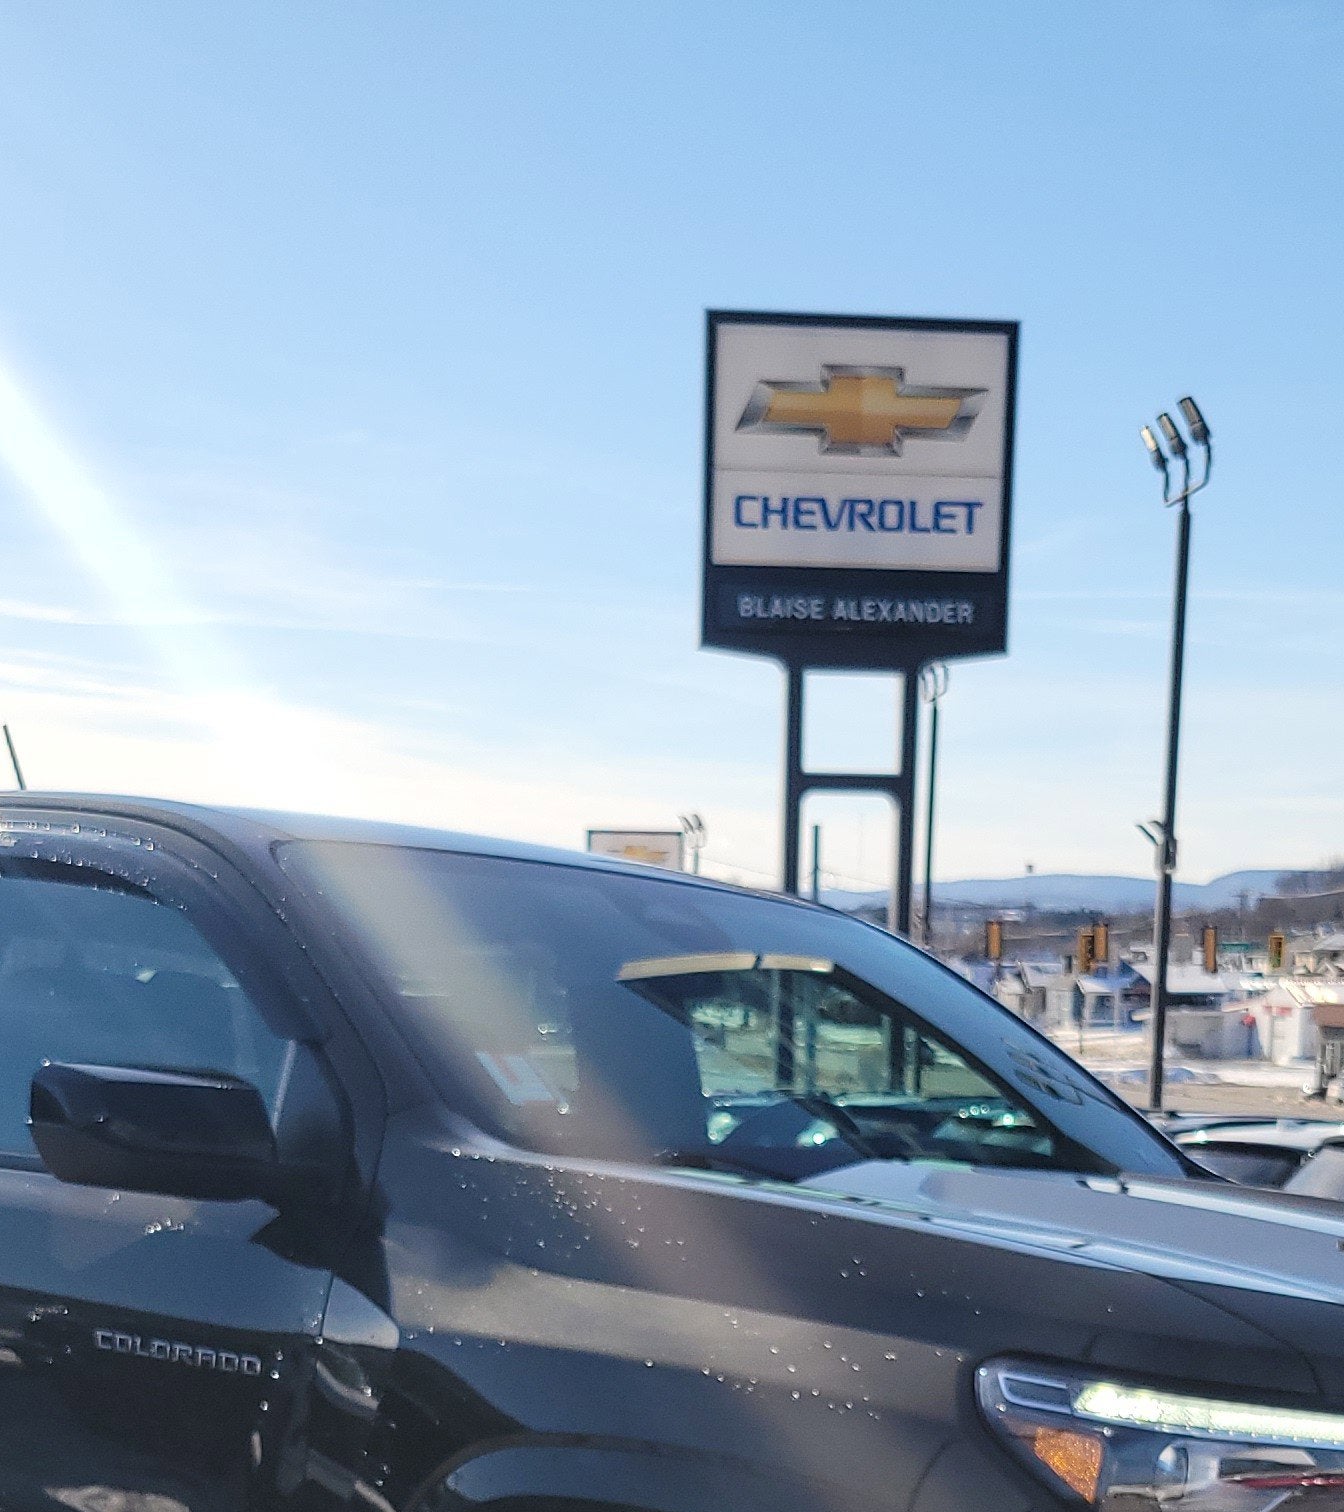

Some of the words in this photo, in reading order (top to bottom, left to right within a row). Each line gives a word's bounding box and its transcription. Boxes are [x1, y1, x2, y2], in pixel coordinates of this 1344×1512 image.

[733, 494, 984, 535] CHEVROLET
[736, 594, 824, 620] BLAISE
[832, 597, 975, 625] ALEXANDER
[93, 1329, 262, 1376] COLORADO
